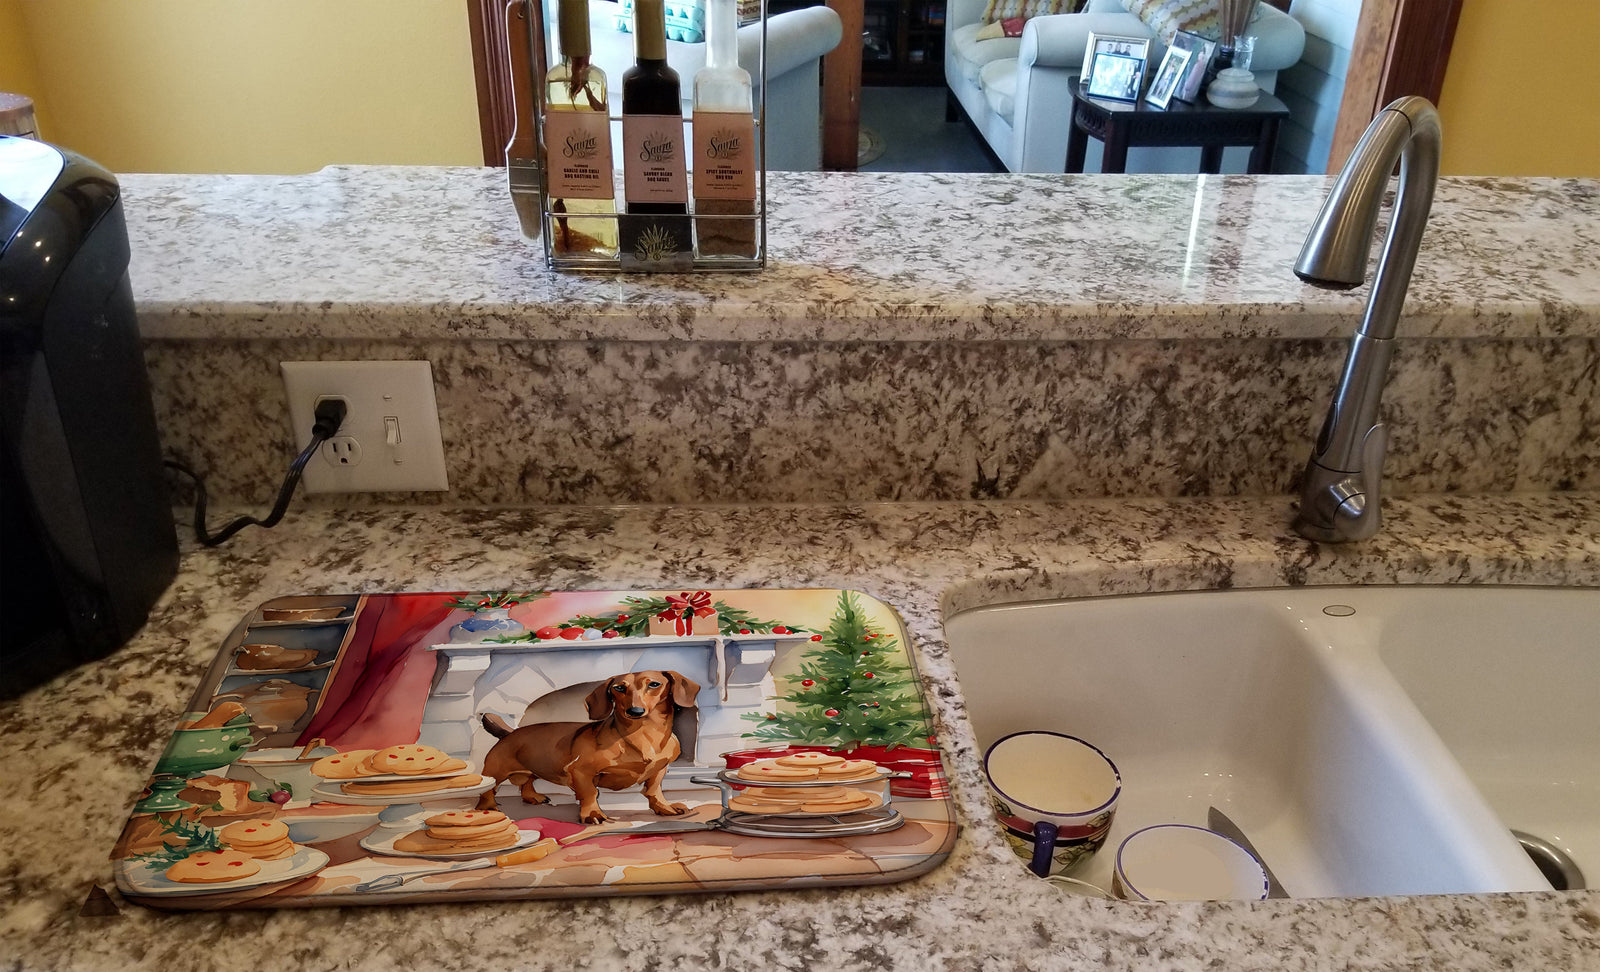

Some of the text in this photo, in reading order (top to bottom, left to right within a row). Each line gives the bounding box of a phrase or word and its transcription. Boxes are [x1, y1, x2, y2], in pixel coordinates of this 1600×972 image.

[563, 136, 597, 158] Sauza
[640, 140, 674, 162] Sauza
[706, 136, 740, 158] Sauza
